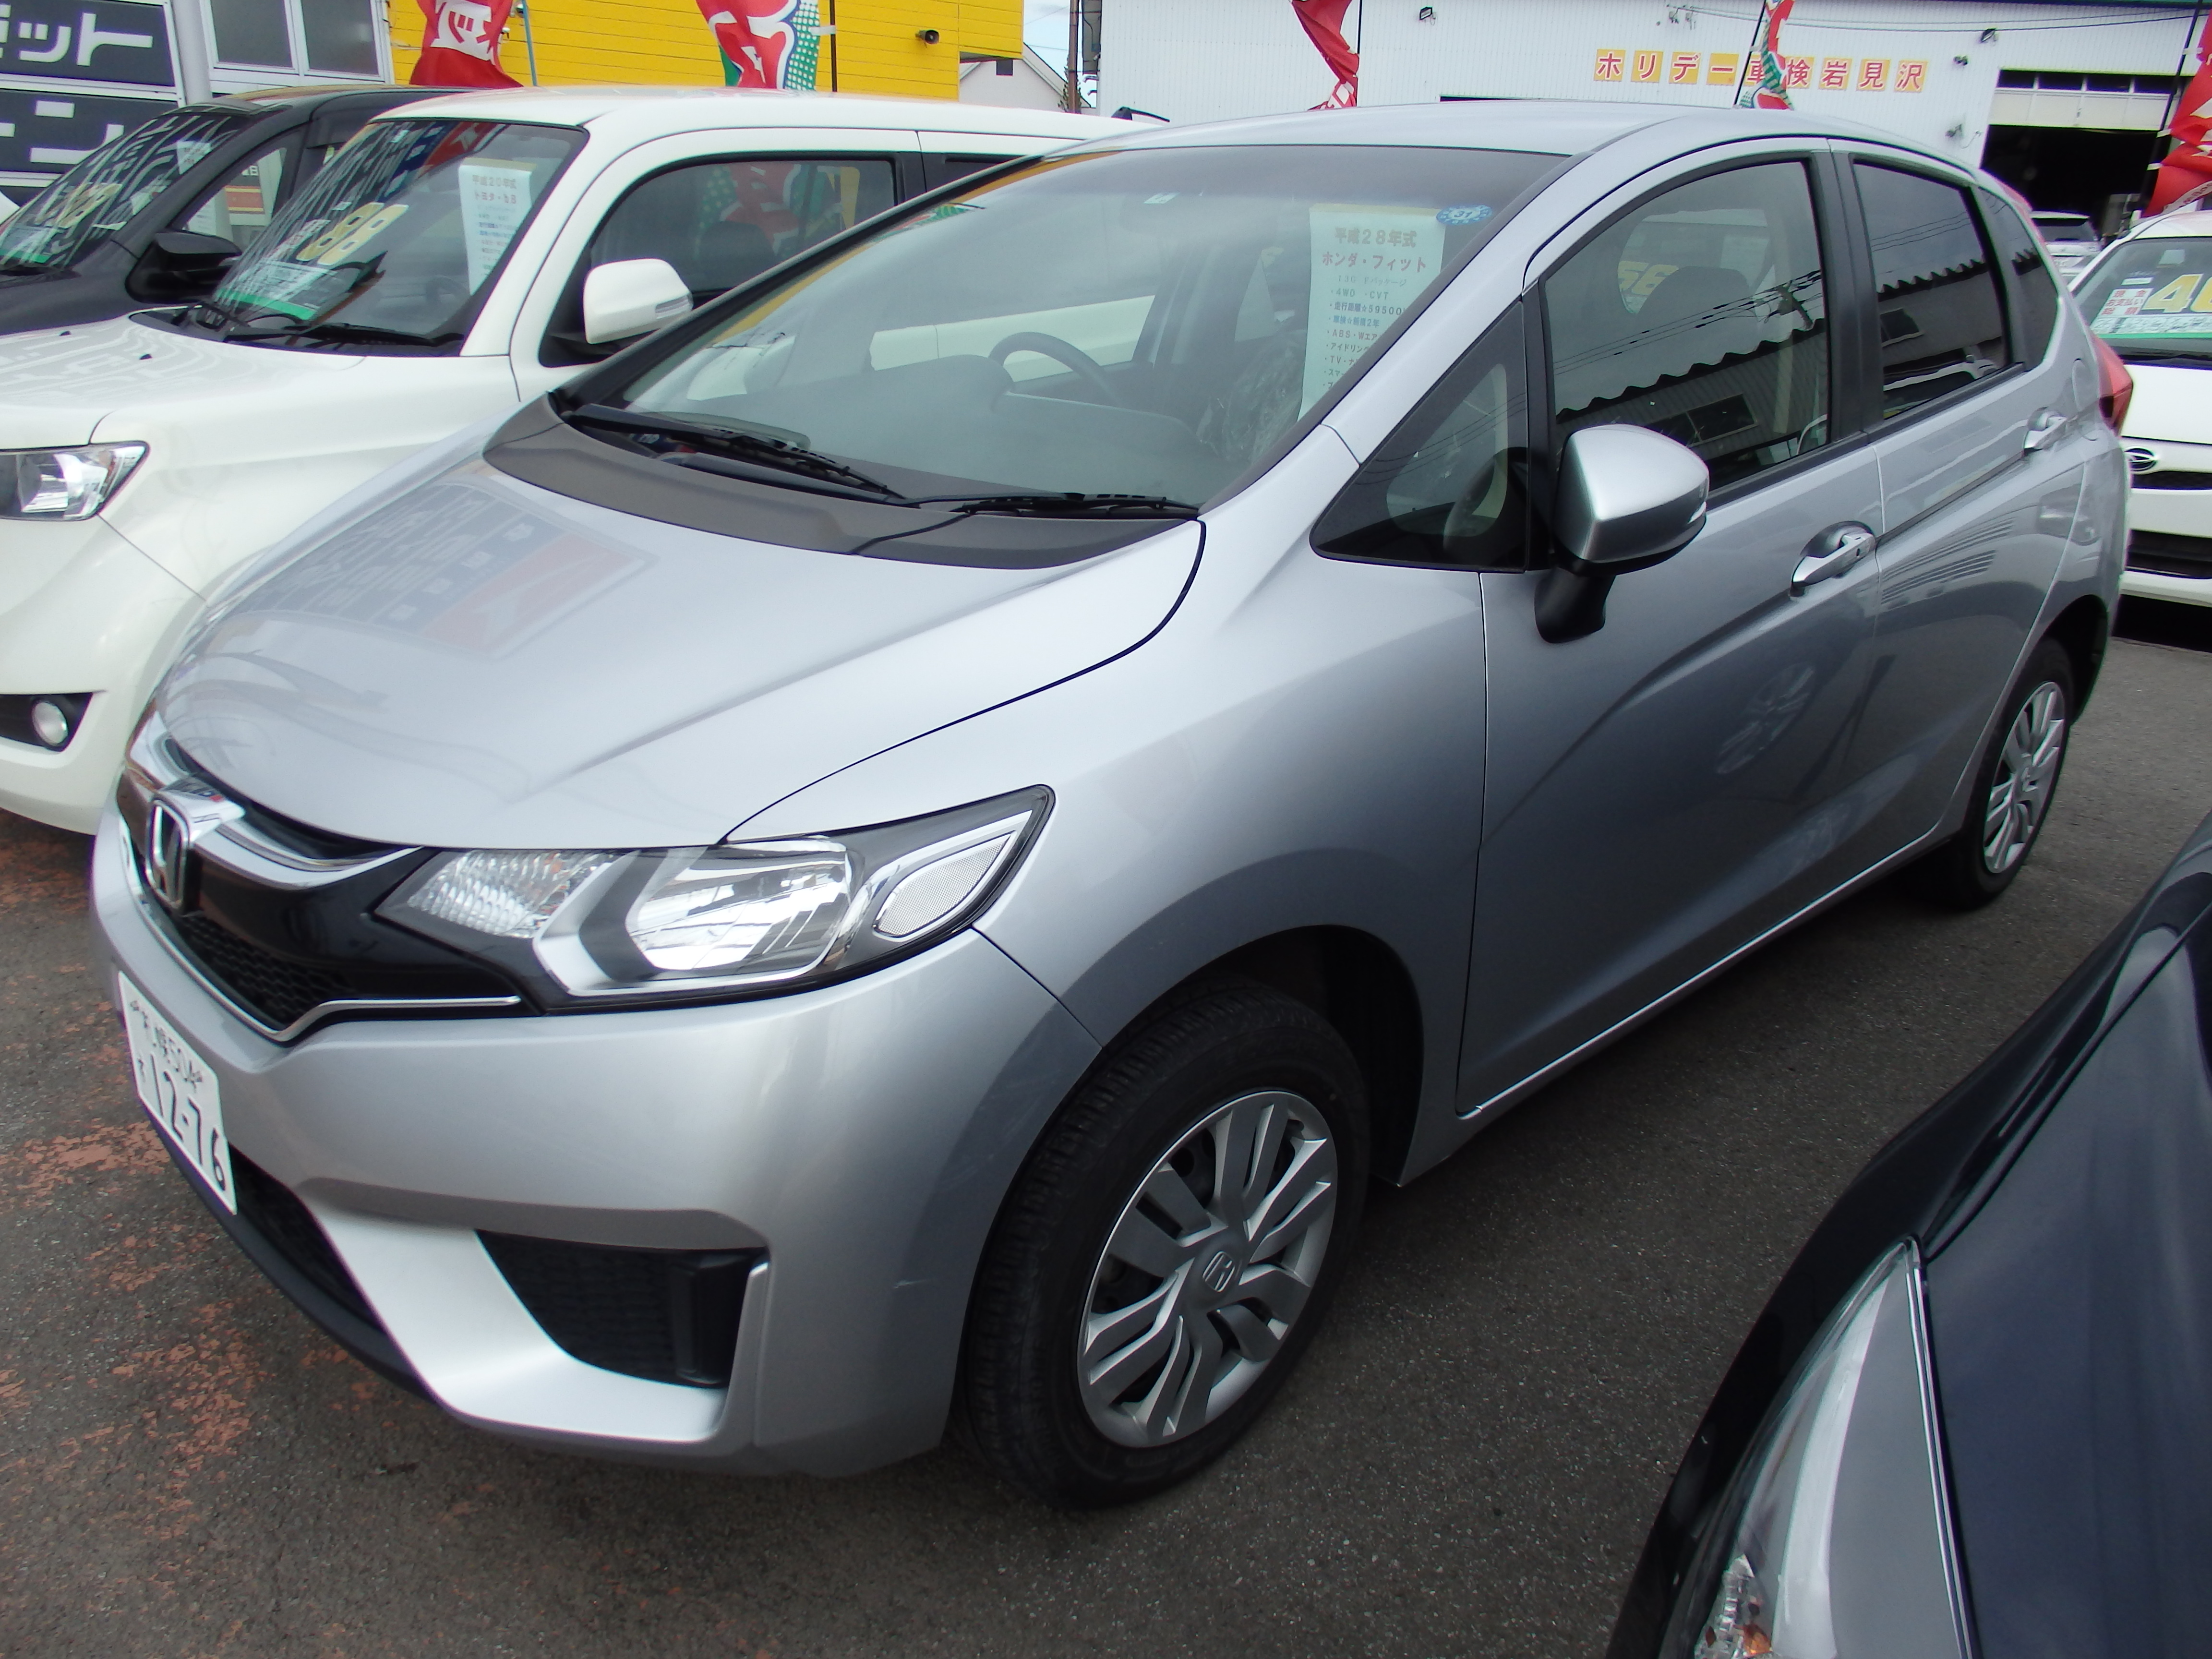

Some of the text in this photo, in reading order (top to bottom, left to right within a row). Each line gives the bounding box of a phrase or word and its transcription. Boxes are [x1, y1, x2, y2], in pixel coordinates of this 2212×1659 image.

[1597, 51, 1923, 91] ホリデー車検岩見沢
[1334, 227, 1418, 248] 平成28年式
[1322, 251, 1426, 273] ホンダ・フィット
[1617, 260, 1679, 295] 56
[149, 1053, 226, 1191] 12-76
